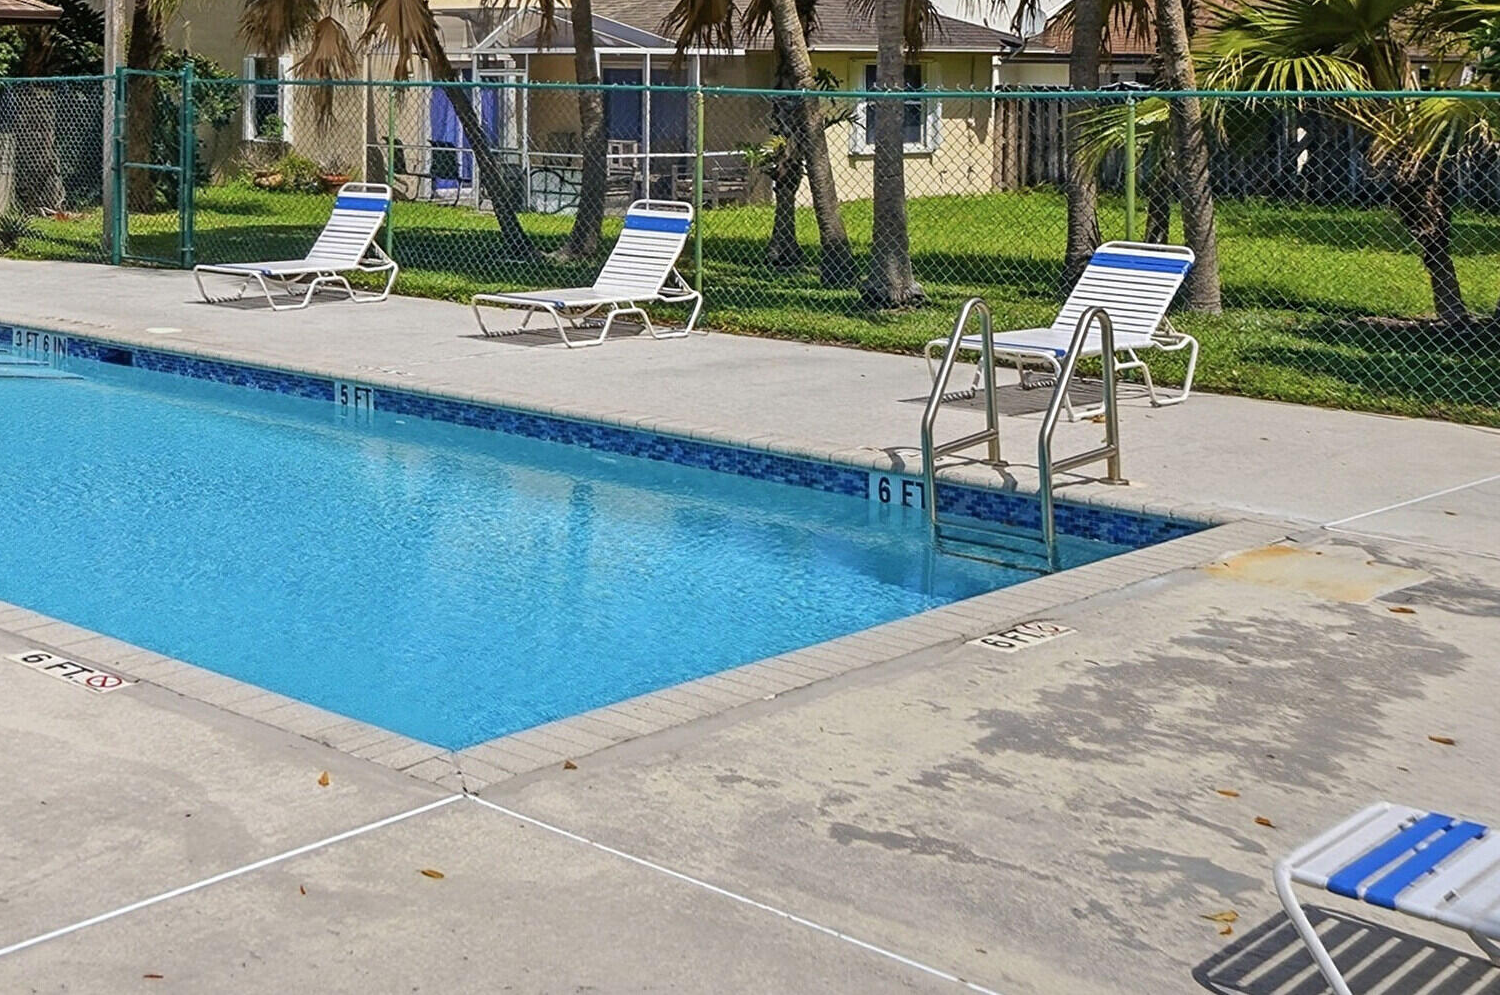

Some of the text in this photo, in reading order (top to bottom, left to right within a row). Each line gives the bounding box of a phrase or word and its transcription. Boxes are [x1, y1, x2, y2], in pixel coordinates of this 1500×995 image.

[26, 331, 39, 350] FT
[43, 334, 49, 352] 6
[53, 336, 66, 354] IN
[340, 384, 372, 409] 5 FT
[878, 476, 926, 509] 6 FT
[981, 638, 1016, 648] 6
[21, 653, 53, 663] 6
